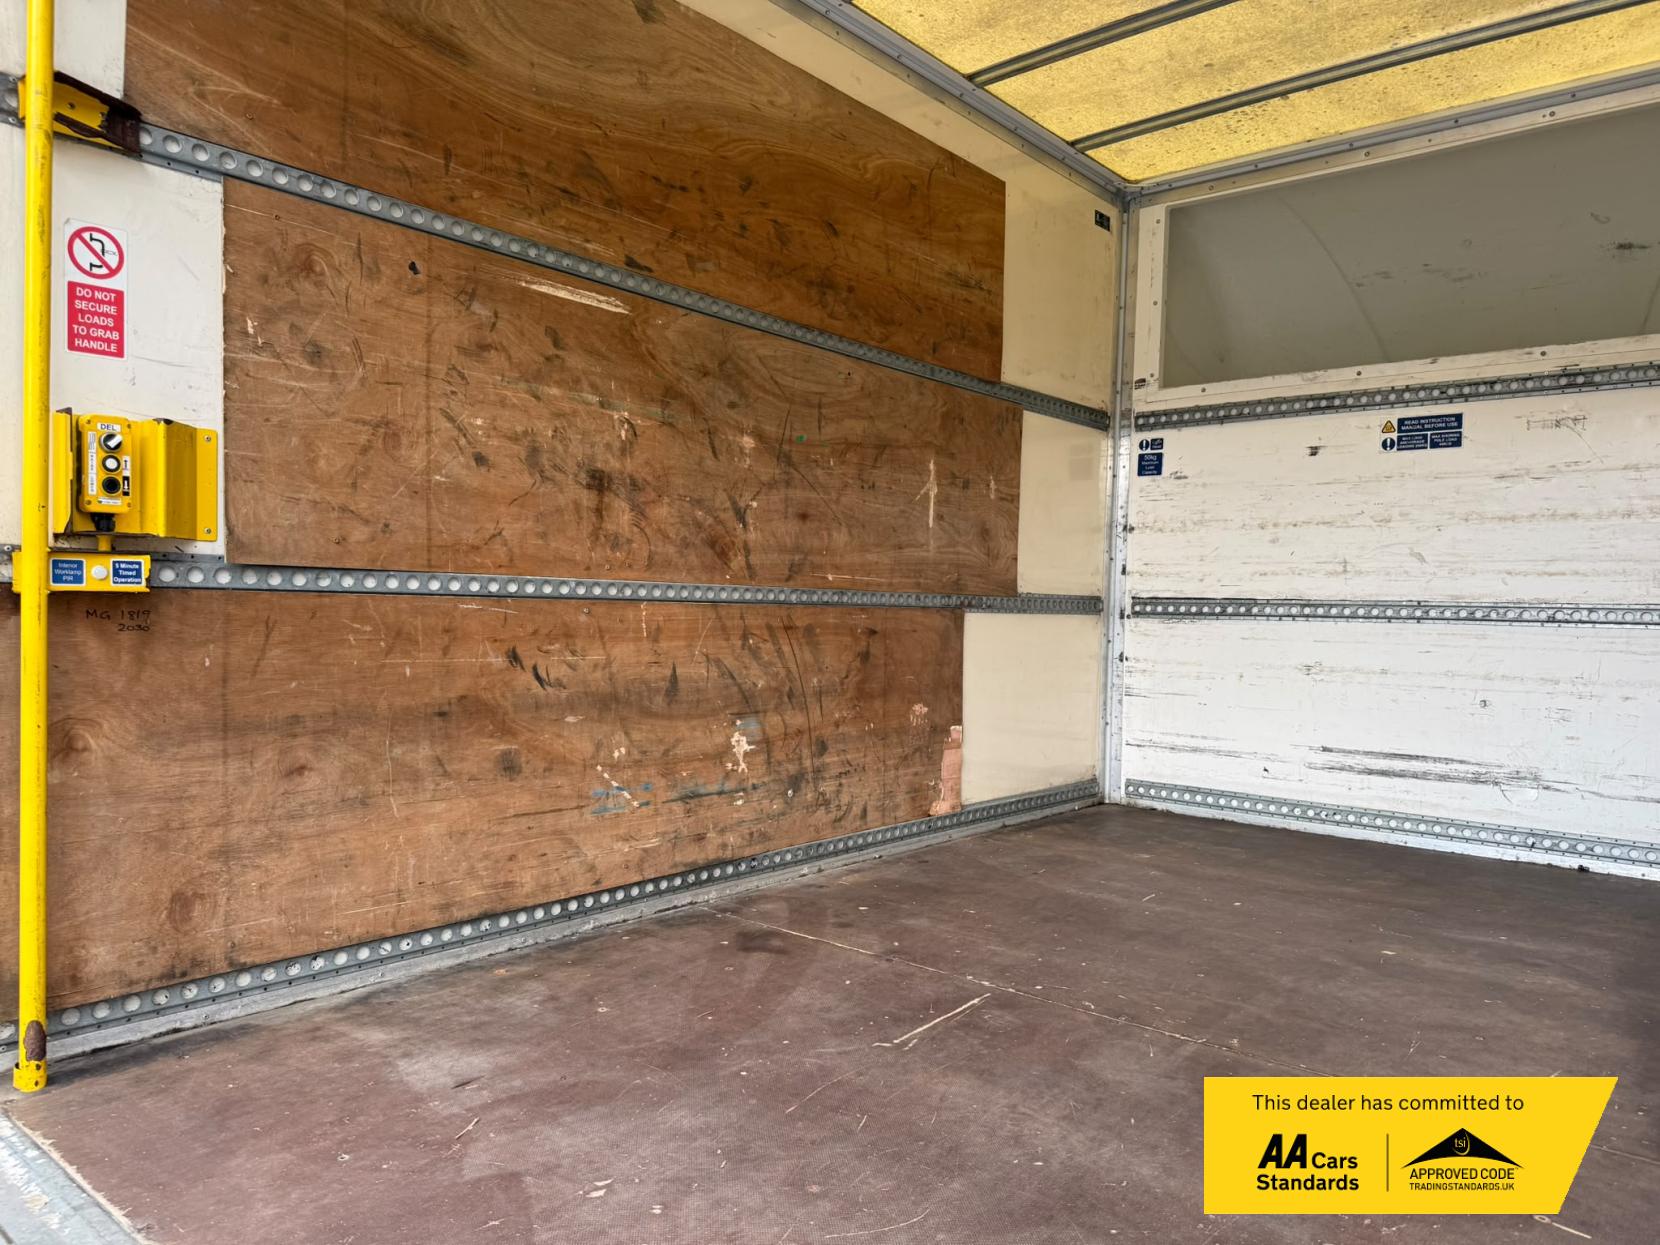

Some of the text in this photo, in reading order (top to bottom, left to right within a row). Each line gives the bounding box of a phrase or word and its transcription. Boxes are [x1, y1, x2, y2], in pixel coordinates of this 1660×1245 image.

[76, 287, 116, 302] DO NOT
[75, 300, 117, 315] SECURE
[78, 313, 114, 327] LOADS
[72, 324, 119, 340] TO GRAB
[75, 338, 117, 352] HANDLE
[100, 423, 117, 431] DEL
[54, 568, 82, 576] Worklamp
[86, 609, 111, 620] MG
